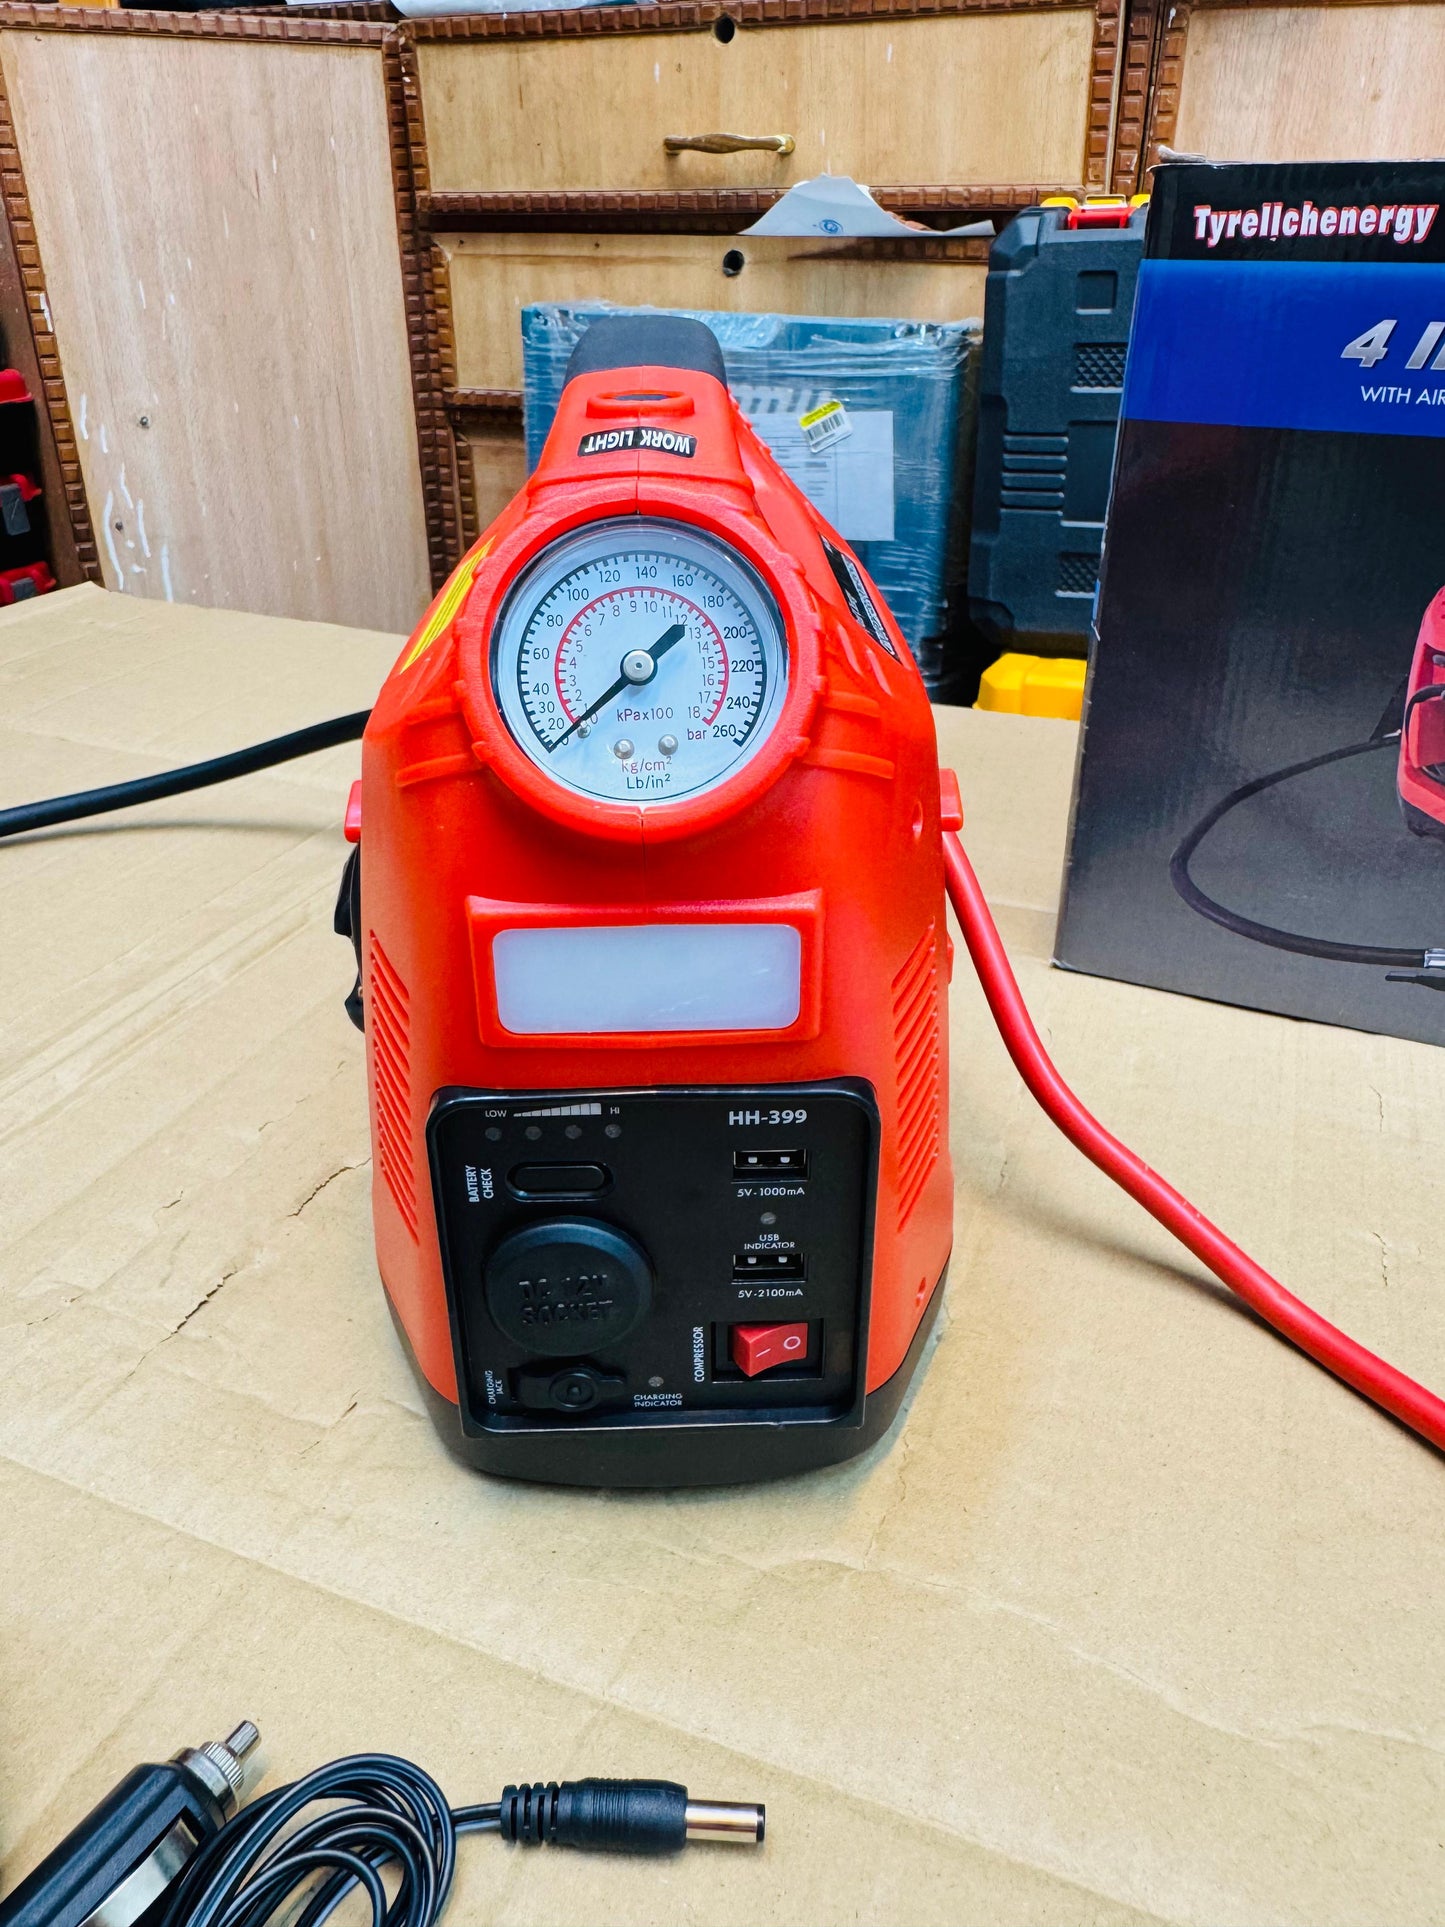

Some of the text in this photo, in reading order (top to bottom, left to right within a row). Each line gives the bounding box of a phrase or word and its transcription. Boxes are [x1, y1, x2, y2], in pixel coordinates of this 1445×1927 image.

[1193, 200, 1439, 248] Tyrellchenergy
[1340, 319, 1445, 370] 4 I
[1360, 385, 1445, 405] WITH AIR
[584, 429, 690, 454] WORK LIGHT
[599, 570, 620, 583] 120
[635, 565, 657, 579] 140
[672, 574, 693, 587] 160
[567, 588, 589, 601] 100
[630, 601, 637, 612] 9
[644, 601, 657, 613] 10
[702, 595, 724, 608] 180
[612, 605, 620, 617] 8
[662, 605, 672, 618] 11
[546, 615, 563, 627] 80
[598, 613, 605, 626] 7
[675, 614, 688, 626] 12
[584, 625, 592, 636] 6
[690, 627, 702, 639] 13
[724, 626, 747, 639] 200
[575, 640, 583, 653] 5
[698, 641, 709, 653] 14
[533, 647, 549, 660] 60
[569, 656, 577, 669] 4
[702, 656, 715, 669] 15
[731, 660, 754, 672] 220
[569, 674, 577, 687] 3
[702, 674, 715, 686] 16
[533, 683, 549, 695] 40
[575, 689, 582, 701] 2
[699, 691, 711, 703] 17
[726, 696, 750, 709] 240
[538, 701, 555, 713] 30
[688, 705, 701, 719] 18
[616, 707, 673, 722] kPax100
[548, 717, 565, 730] 20
[687, 728, 707, 740] bar
[713, 724, 736, 738] 260
[626, 774, 670, 789] Lb/in²
[485, 1106, 620, 1118] LOW HI
[729, 1109, 808, 1126] HH-399
[465, 1165, 480, 1203] BATTERY
[480, 1168, 494, 1199] CHECK
[759, 1233, 780, 1242] USB
[744, 1242, 796, 1250] INDICATOR
[693, 1326, 704, 1383] COMPRESSOR
[633, 1393, 683, 1401] CHARGING
[634, 1400, 683, 1408] INDICATOR
